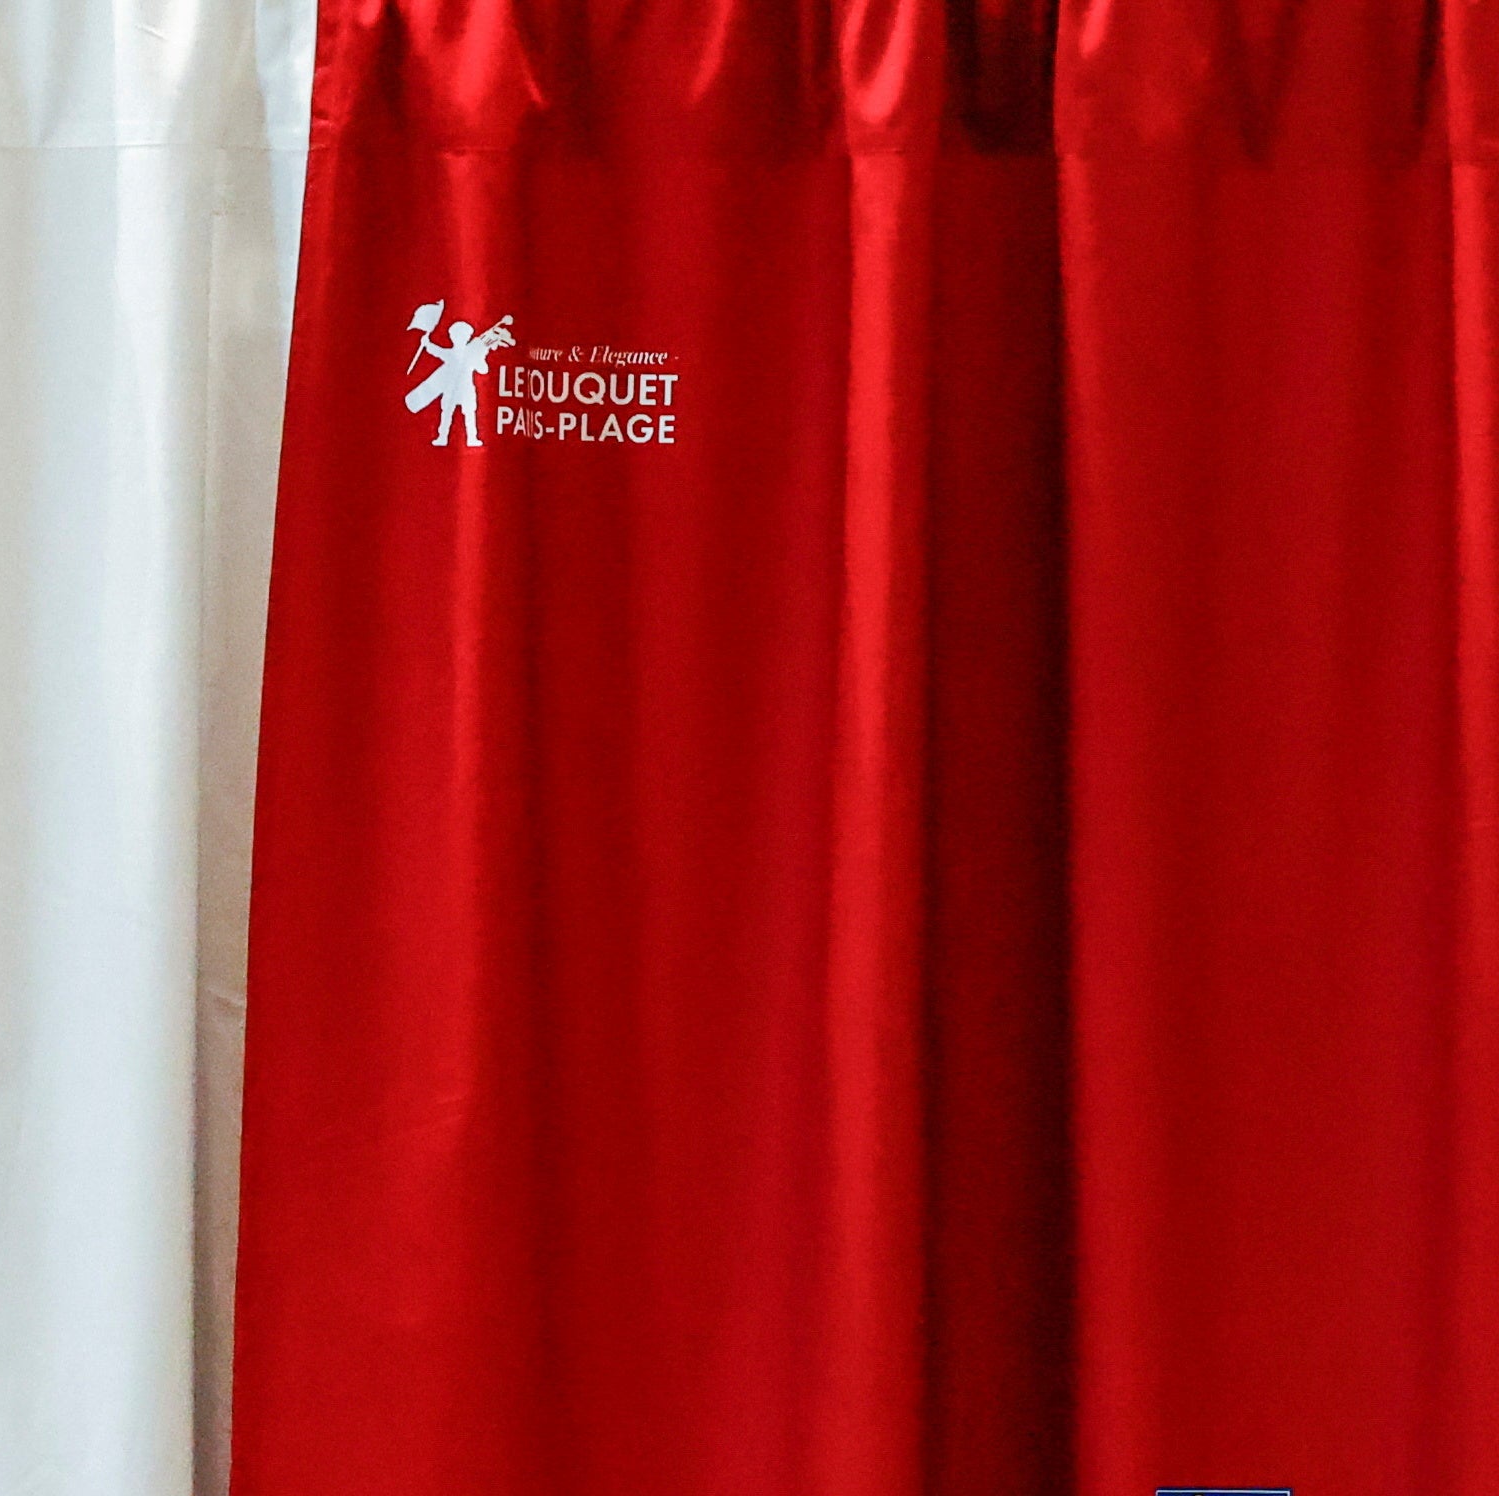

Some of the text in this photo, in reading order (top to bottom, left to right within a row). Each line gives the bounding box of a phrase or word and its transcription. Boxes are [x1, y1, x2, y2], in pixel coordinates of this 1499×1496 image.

[568, 345, 584, 363] &
[590, 345, 669, 368] Elegance
[498, 365, 679, 406] LE OUQUET
